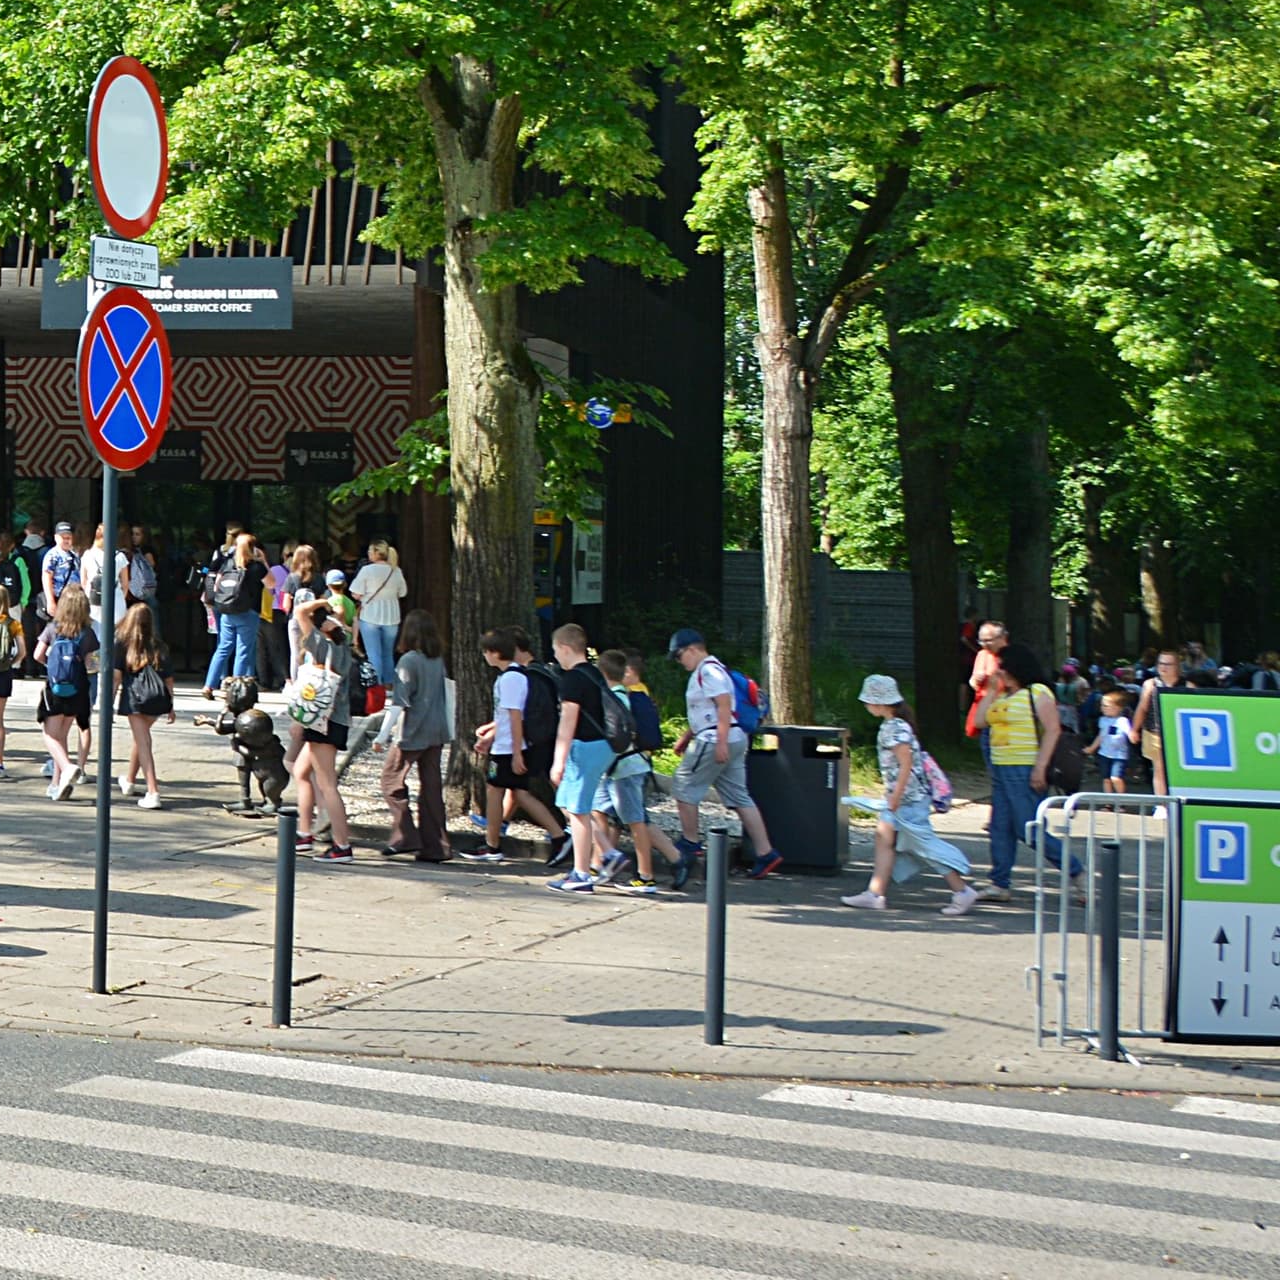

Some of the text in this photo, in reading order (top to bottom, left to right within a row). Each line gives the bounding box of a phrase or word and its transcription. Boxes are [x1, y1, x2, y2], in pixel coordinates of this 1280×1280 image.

[183, 303, 220, 313] SERVICE
[220, 303, 253, 313] OFFICE
[159, 448, 186, 458] KASA
[310, 450, 338, 459] KASA
